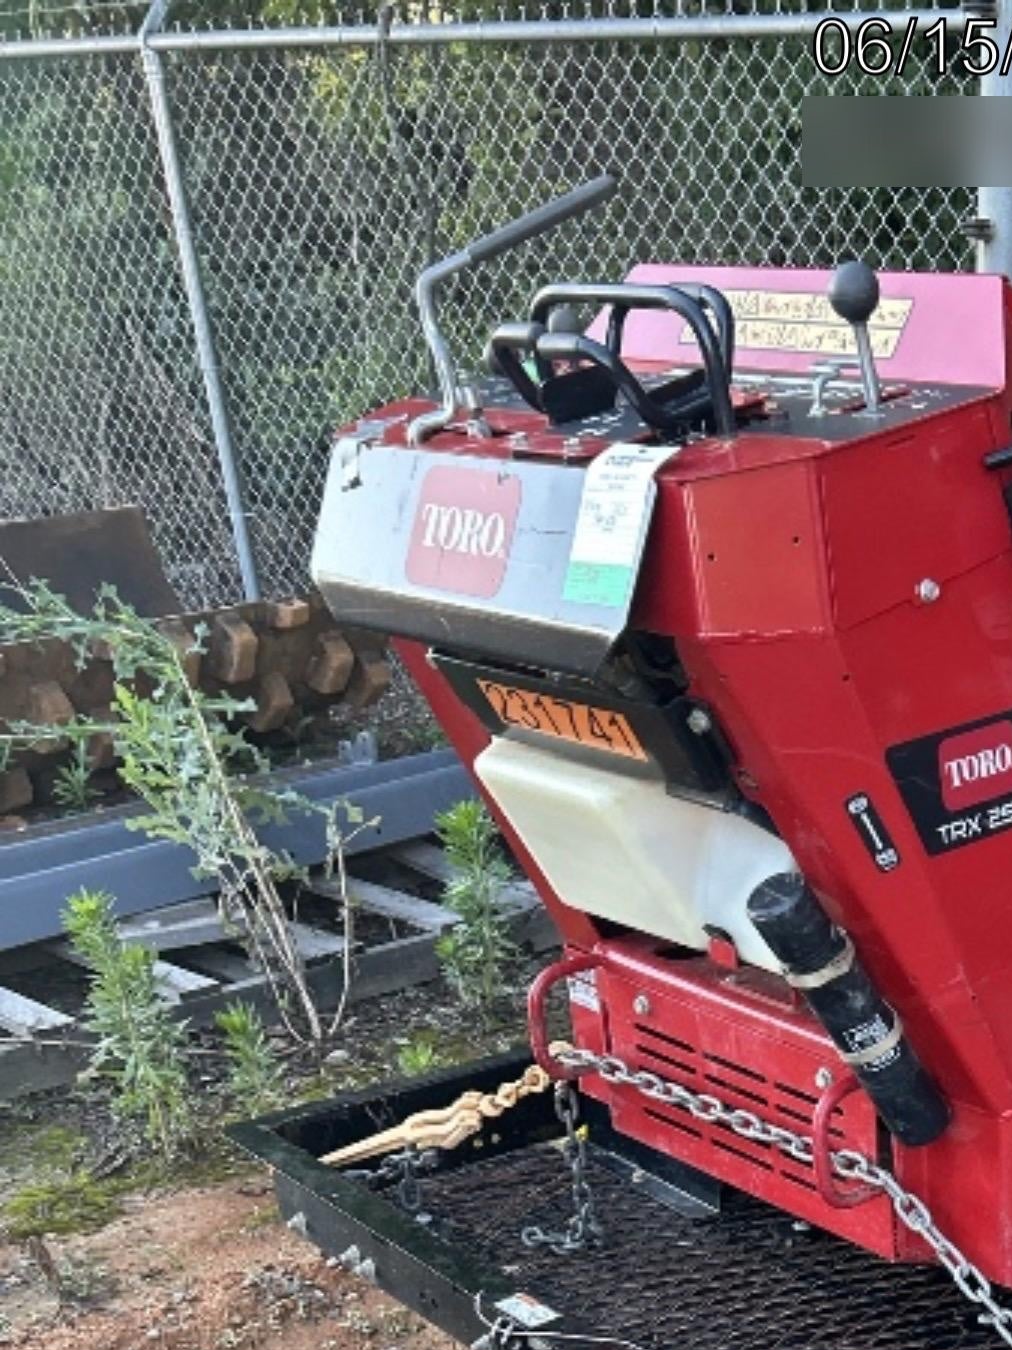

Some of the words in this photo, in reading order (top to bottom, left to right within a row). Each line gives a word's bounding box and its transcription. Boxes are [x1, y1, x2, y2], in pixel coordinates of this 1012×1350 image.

[421, 503, 505, 557] TORO
[485, 683, 636, 756] 231741
[936, 813, 982, 844] TRX
